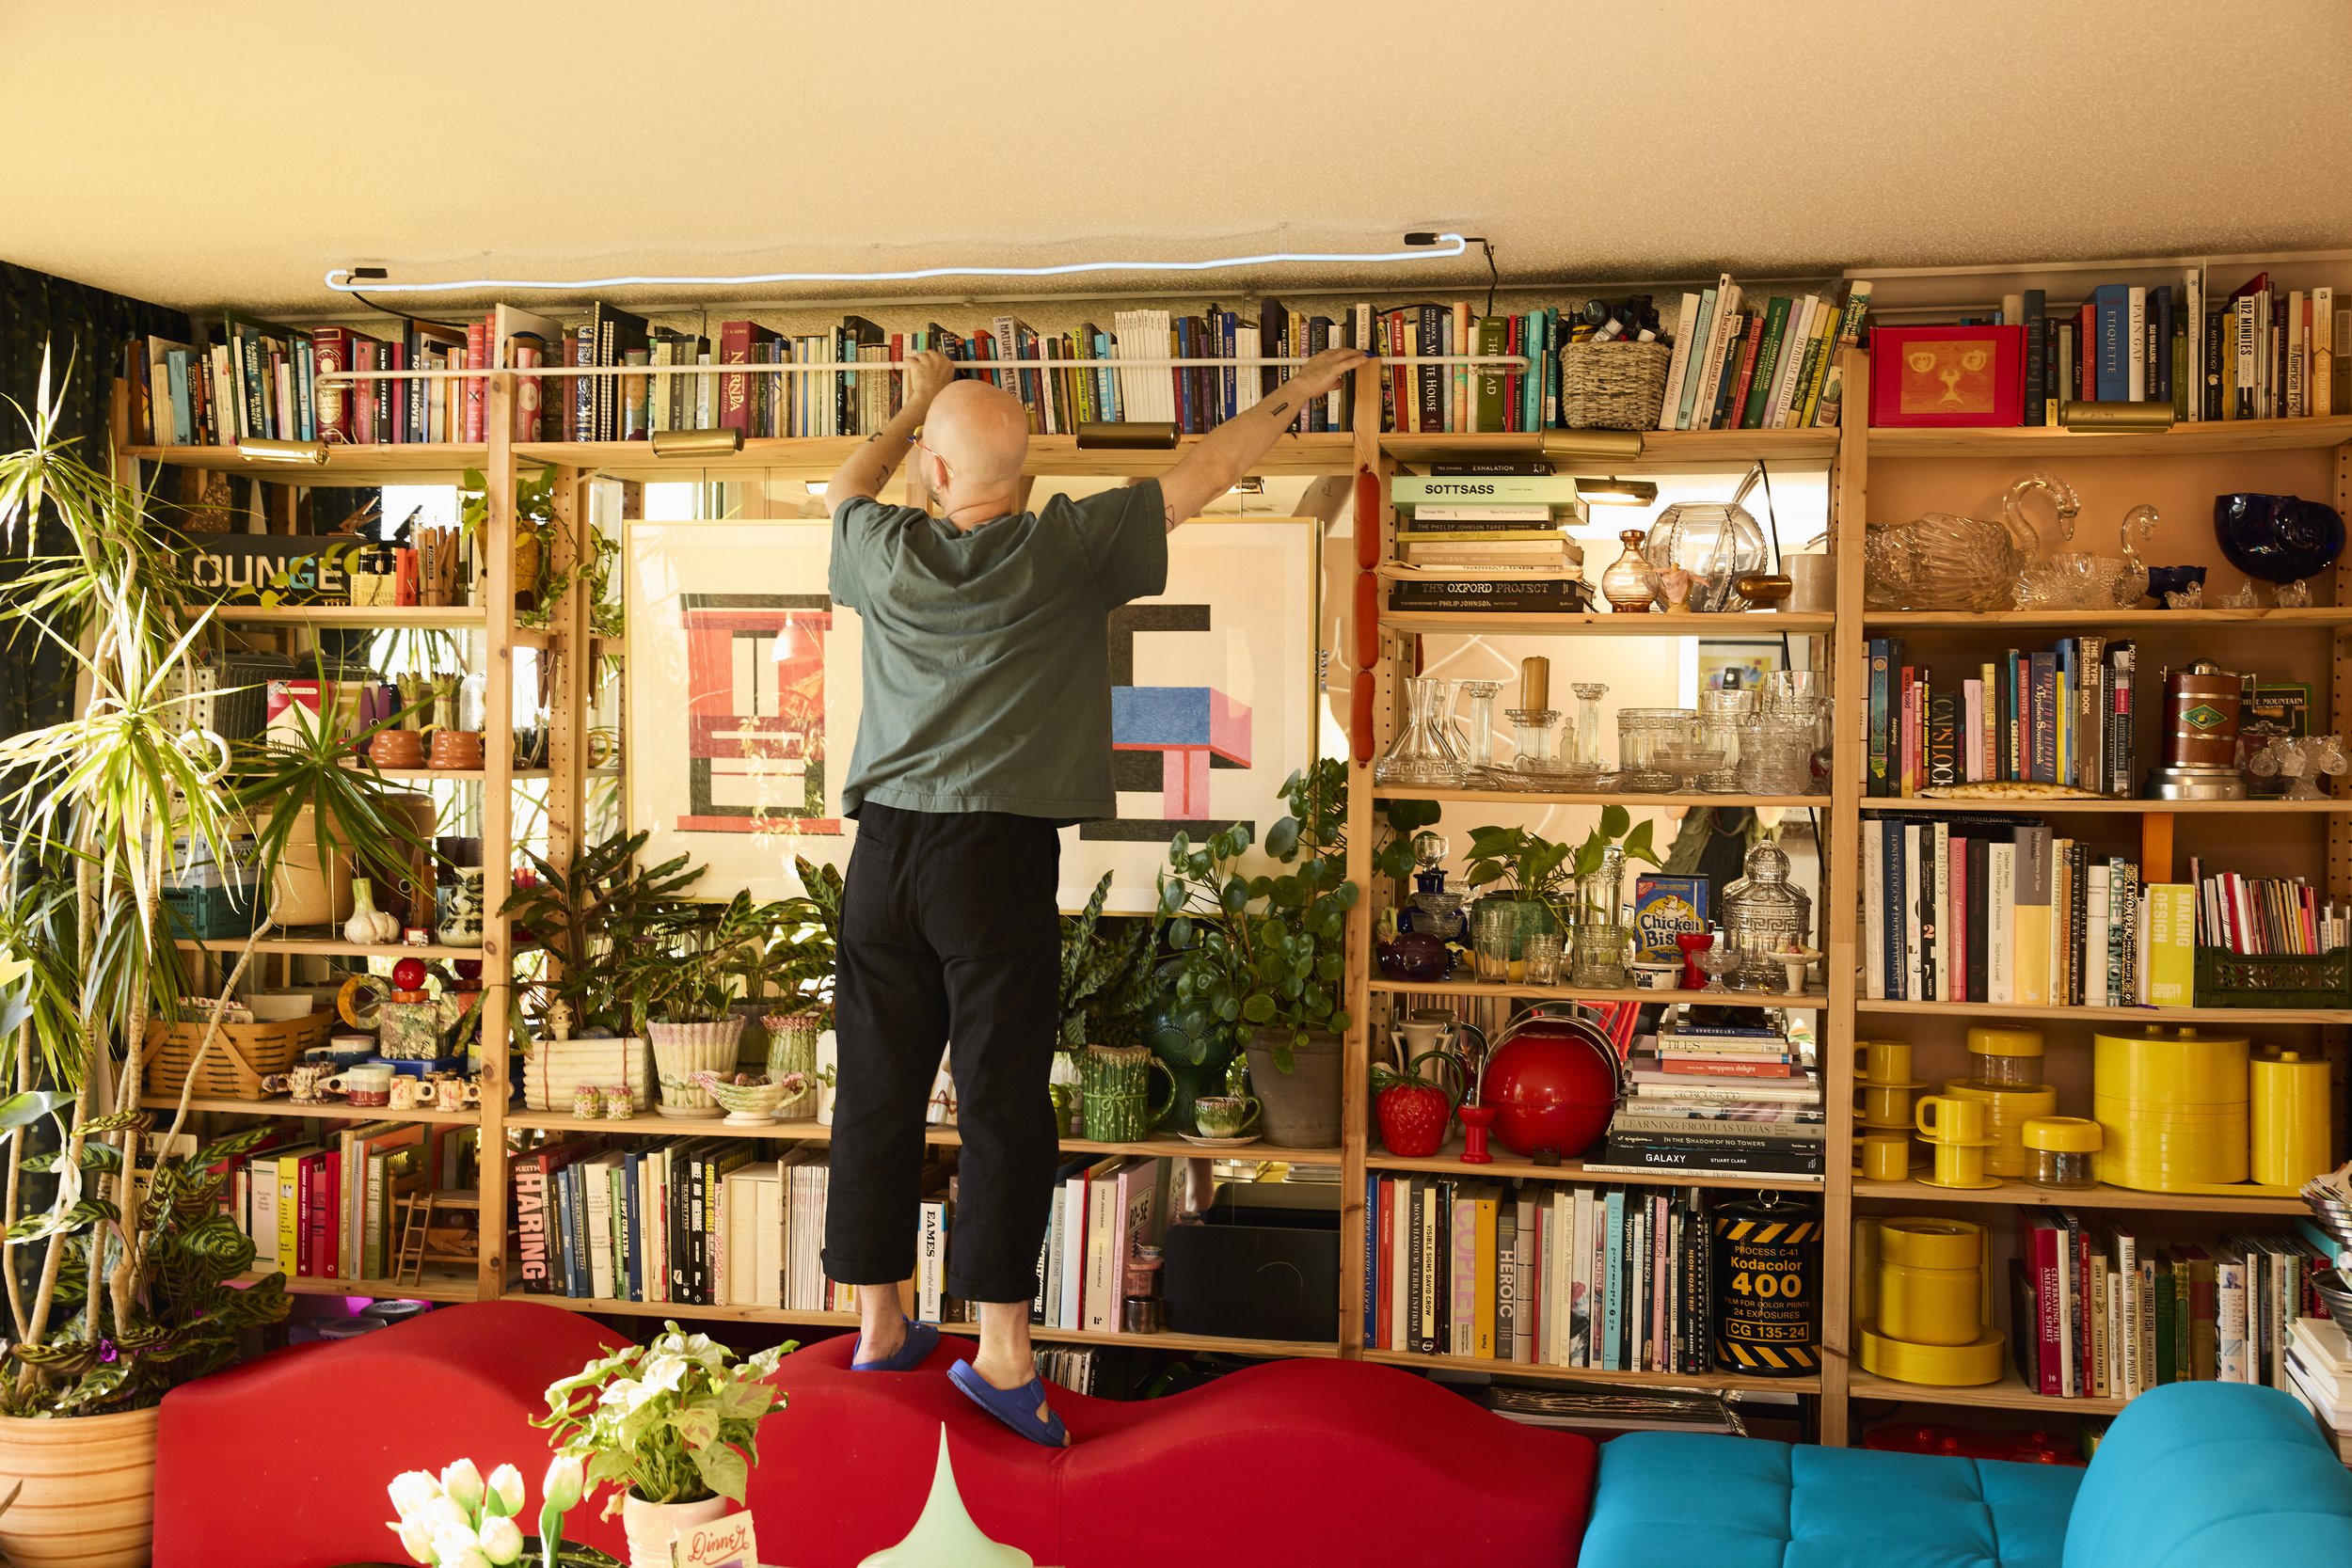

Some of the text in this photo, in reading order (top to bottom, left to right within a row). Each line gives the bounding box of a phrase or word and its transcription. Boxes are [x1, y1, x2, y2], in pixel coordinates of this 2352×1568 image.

[2107, 310, 2116, 372] ETIQUETTE
[2241, 300, 2252, 355] 102 MINUTES
[1426, 345, 1437, 376] WTE
[1746, 324, 1760, 366] bell hooks
[1778, 337, 1804, 416] JAPANESE ALPHABET
[2290, 353, 2302, 389] American
[2318, 356, 2329, 411] opening up
[411, 394, 420, 428] MOVES
[1426, 380, 1438, 412] HOUSE
[1425, 484, 1494, 494] SOTTSASS
[169, 555, 342, 590] LOUNGE
[1422, 583, 1549, 593] THE OXFORD PROJECT
[1933, 699, 1954, 740] CAPS
[2035, 690, 2045, 721] Typeface
[2036, 721, 2045, 764] Sourcebook
[1641, 913, 1700, 932] Chicken
[2107, 858, 2123, 1006] MORE IS MORE
[2153, 893, 2168, 942] DESIGN
[2176, 894, 2191, 947] MAKING
[1636, 973, 1653, 983] PLAIN
[1667, 1040, 1700, 1051] TILES
[1622, 1119, 1771, 1133] LEARNING FROM LAS VEGAS
[369, 1158, 380, 1181] HOME
[1645, 1153, 1686, 1164] GALAXY
[369, 1181, 379, 1200] HEAT
[706, 1164, 714, 1232] GUERRILLA GIRLS
[367, 1201, 378, 1228] MONEY
[516, 1175, 546, 1279] HARING
[1128, 1192, 1151, 1228] RO-SÉ
[927, 1211, 936, 1258] EAMES
[1413, 1228, 1422, 1265] HATOUM:
[1625, 1219, 1633, 1261] hyperwest
[1734, 1245, 1776, 1256] PROCESS
[1412, 1268, 1422, 1293] TERRA
[1455, 1205, 1475, 1324] COPLEY
[1731, 1258, 1803, 1271] Kodacolor
[1500, 1251, 1514, 1319] HEROIC
[1732, 1273, 1802, 1298] 400
[2043, 1268, 2052, 1313] AMERICAN
[2144, 1287, 2153, 1313] TINNED
[1411, 1295, 1421, 1332] INFIRMA
[1740, 1299, 1756, 1307] FOR
[1757, 1300, 1785, 1308] COLOR
[1787, 1300, 1809, 1308] PRINTS
[1746, 1309, 1800, 1319] EXPOSURES
[1731, 1323, 1805, 1338] CG 135-24
[2145, 1315, 2153, 1332] FISH
[688, 1526, 750, 1561] Dinner
